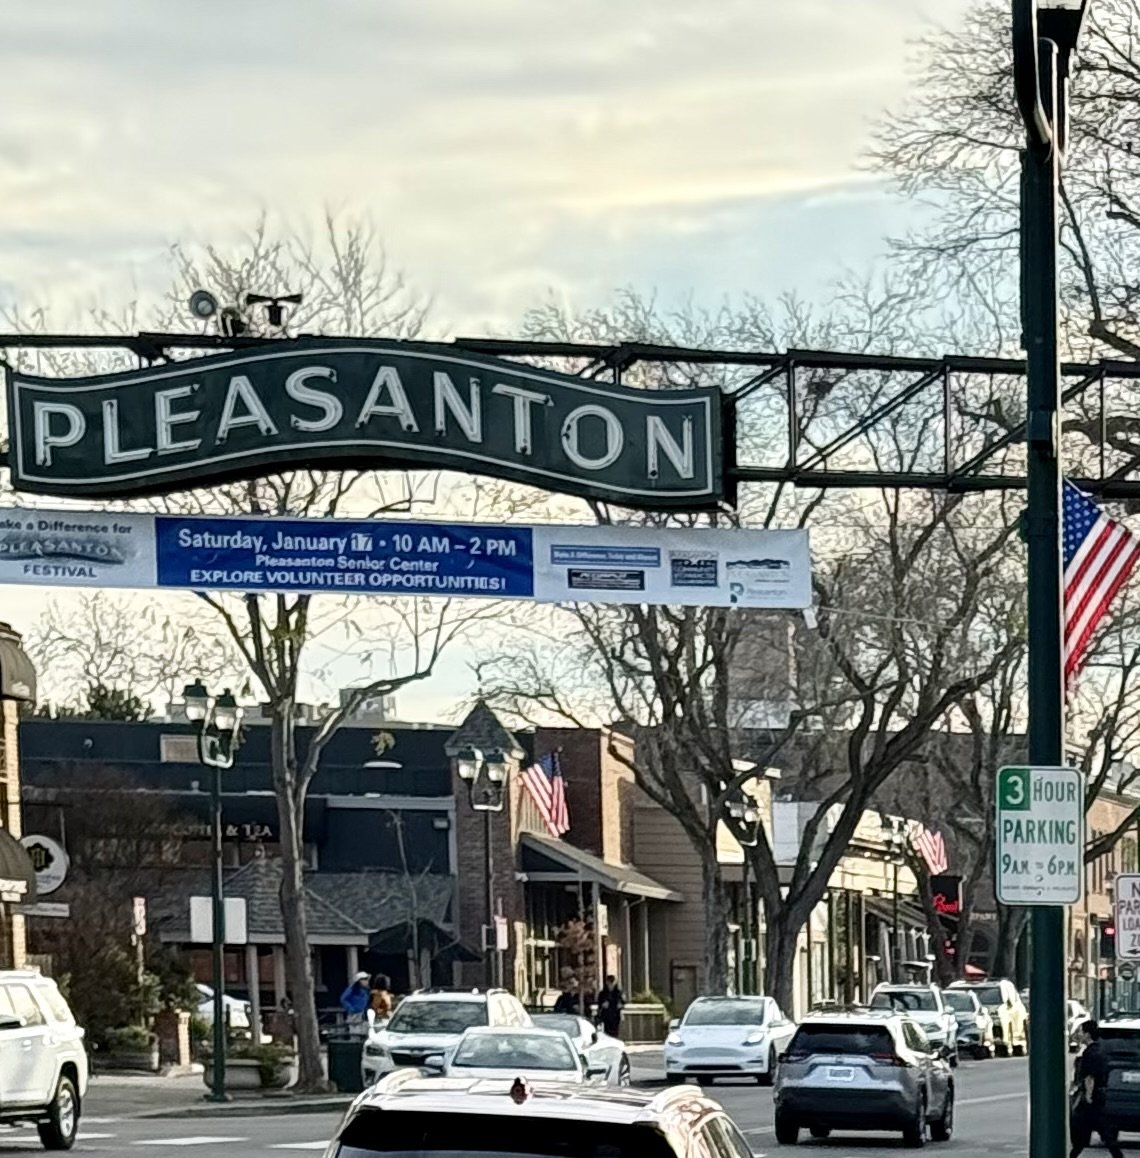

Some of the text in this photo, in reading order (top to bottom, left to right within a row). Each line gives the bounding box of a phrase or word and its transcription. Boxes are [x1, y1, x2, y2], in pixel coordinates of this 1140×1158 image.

[33, 366, 694, 479] PLEASANTON
[0, 520, 22, 531] ake
[38, 521, 109, 533] Difference
[112, 523, 133, 535] for
[179, 528, 268, 554] Saturday,
[272, 531, 348, 555] January
[392, 534, 413, 553] 10
[417, 536, 450, 553] AM
[469, 537, 482, 555] 2
[486, 539, 517, 556] PM
[23, 564, 98, 579] FESTIVAL
[256, 554, 440, 572] Pleasanton Senior Center
[190, 569, 507, 591] EXPLORE VOLUNTEER OPPORTUNITIES!
[1005, 775, 1076, 805] 3 HOUR
[225, 824, 239, 837] &
[1002, 819, 1077, 845] PARKING
